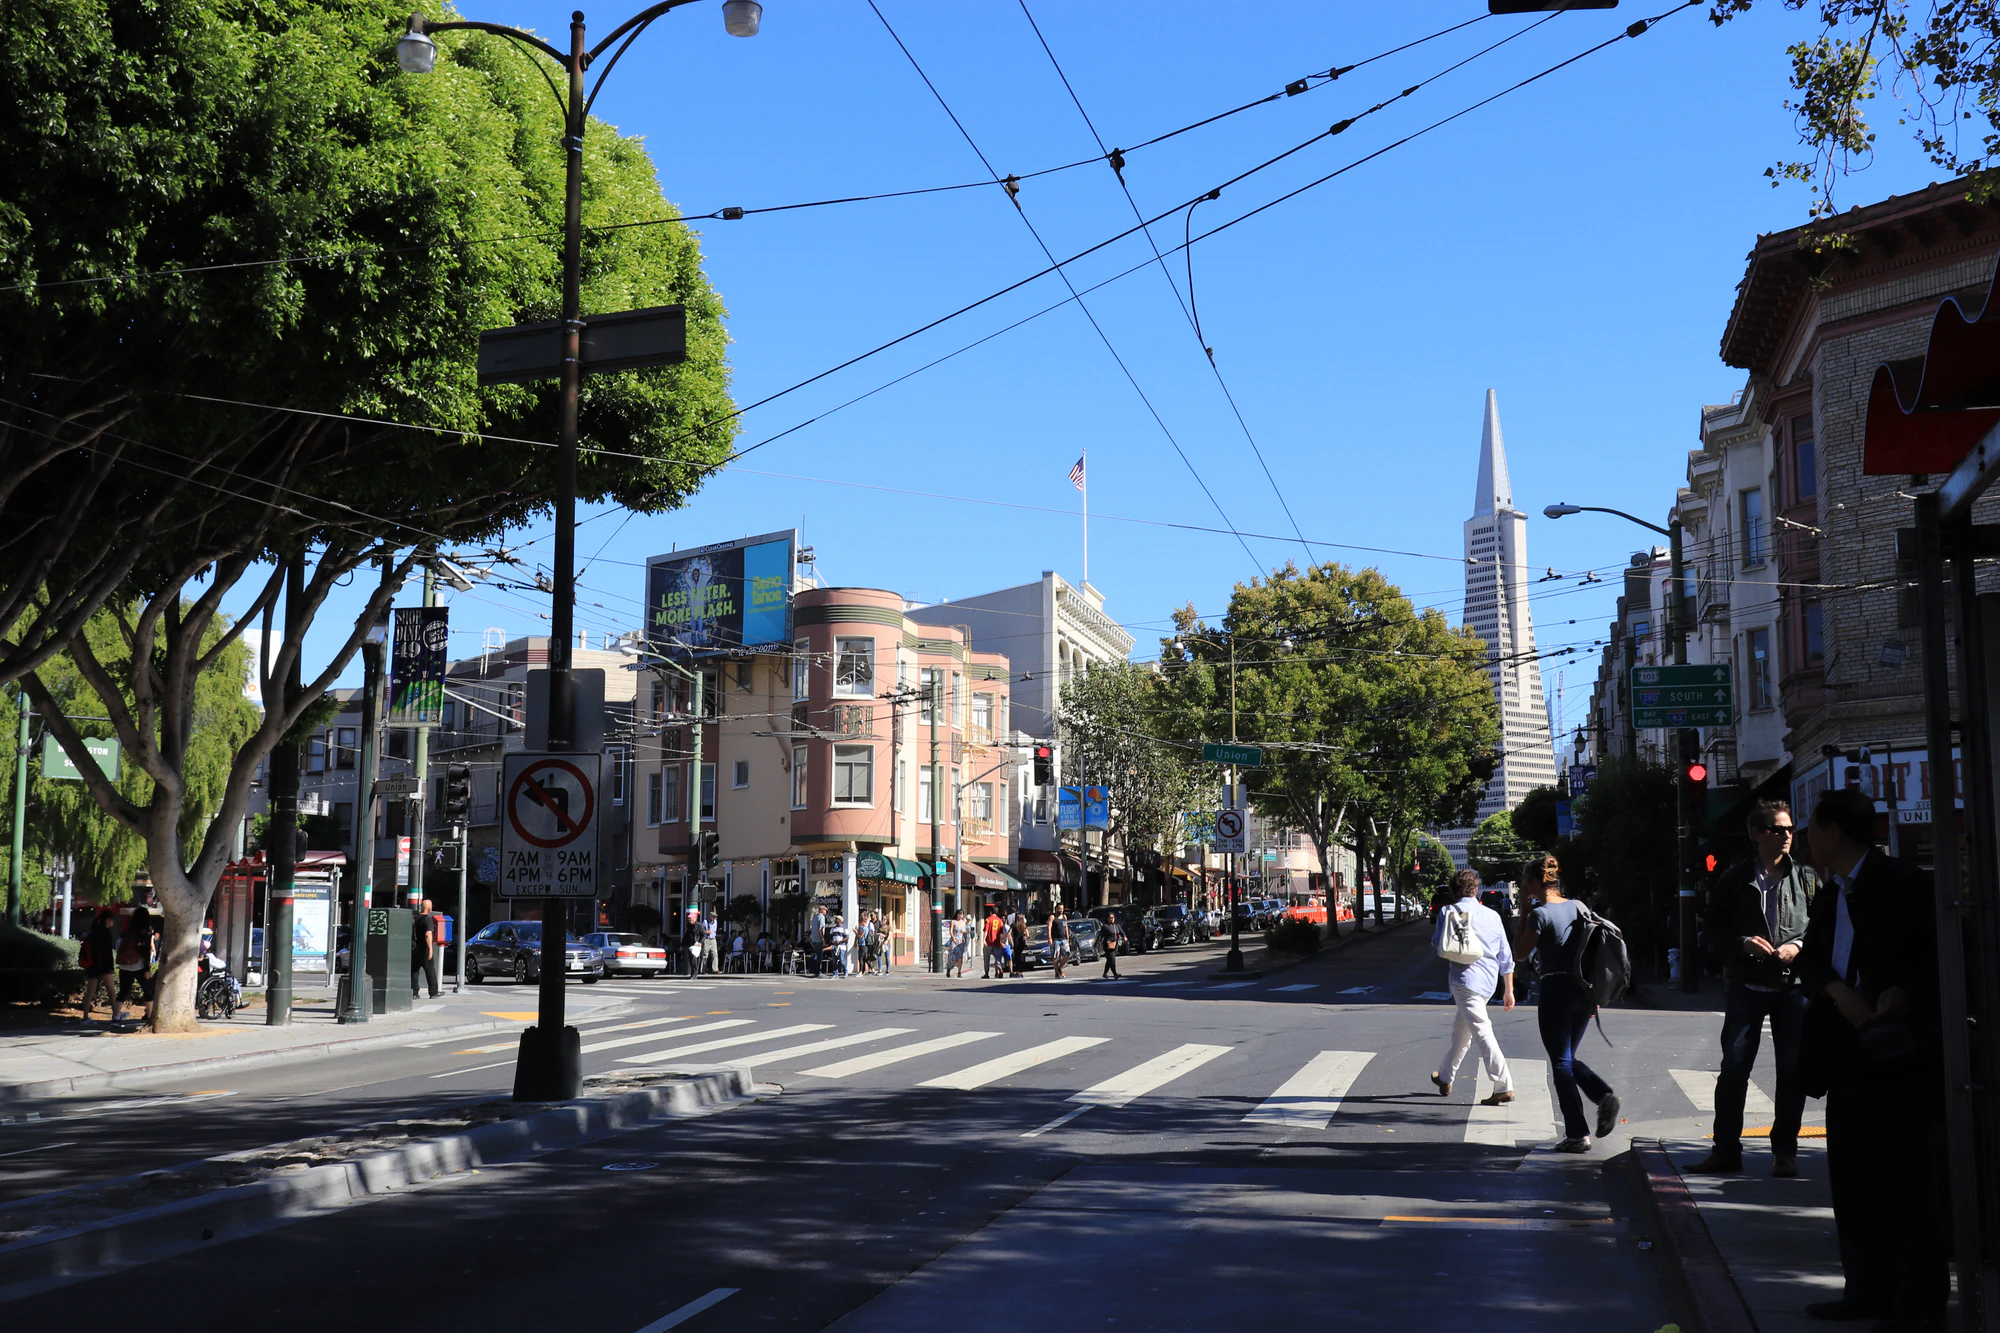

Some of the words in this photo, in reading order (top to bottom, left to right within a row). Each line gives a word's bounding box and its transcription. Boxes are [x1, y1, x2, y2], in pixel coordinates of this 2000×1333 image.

[753, 575, 782, 590] Reno
[661, 591, 687, 608] LESS
[690, 583, 731, 602] FILTER.
[751, 590, 782, 606] Tahoe
[396, 610, 422, 625] SHOP
[656, 607, 691, 626] MORE
[694, 600, 736, 620] FLASH.
[396, 625, 421, 641] DINE
[394, 641, 421, 658] 49
[1670, 692, 1703, 701] SOUTH
[1216, 749, 1248, 760] Union
[385, 783, 407, 791] Union
[508, 851, 539, 866] 7AM
[557, 851, 591, 866] 9AM
[506, 868, 540, 882] 4PM
[558, 868, 591, 882] 6PM
[560, 885, 580, 894] SUN.
[992, 919, 999, 930] 9
